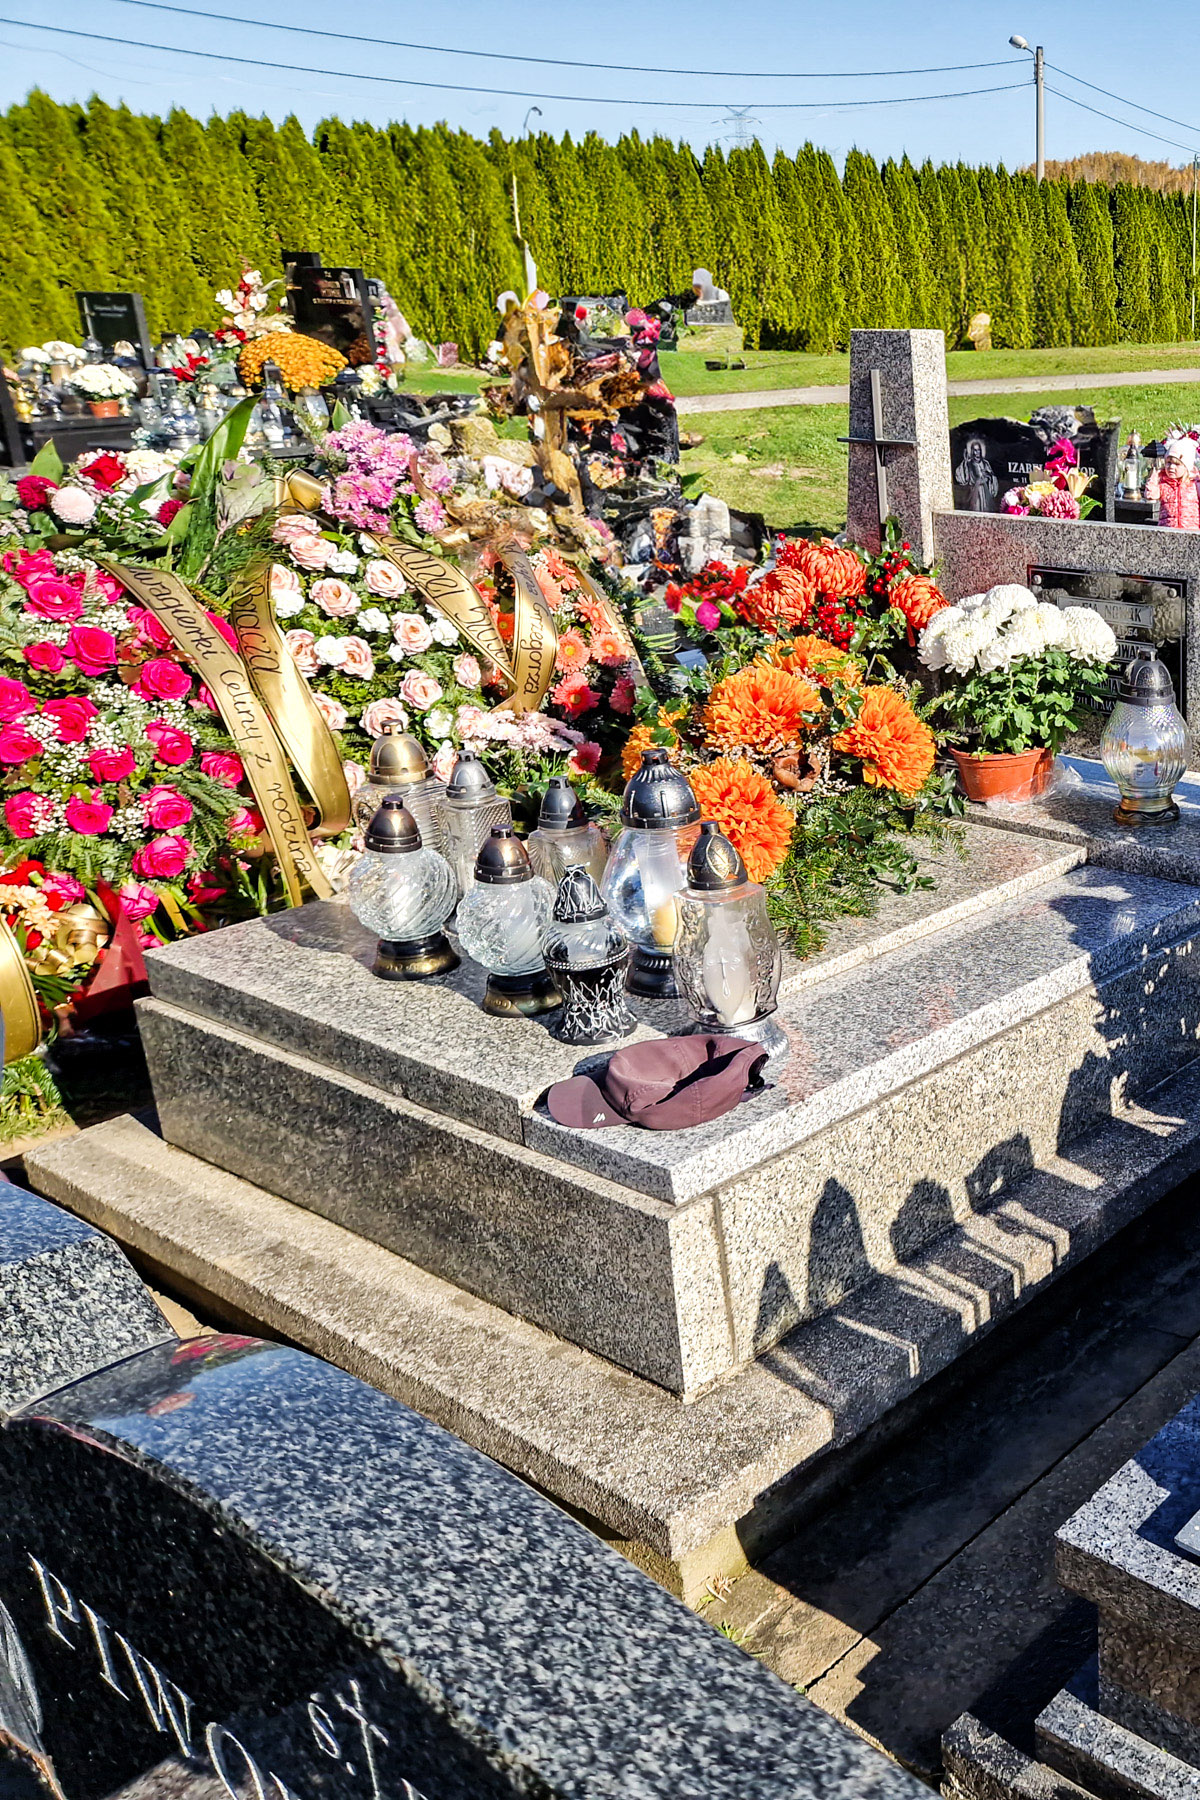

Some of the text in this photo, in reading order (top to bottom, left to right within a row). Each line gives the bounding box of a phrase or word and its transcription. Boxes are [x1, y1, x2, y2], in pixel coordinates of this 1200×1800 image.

[520, 601, 550, 695] Grzegorza
[219, 669, 262, 742] Celiny
[27, 1551, 300, 1800] PIWO
